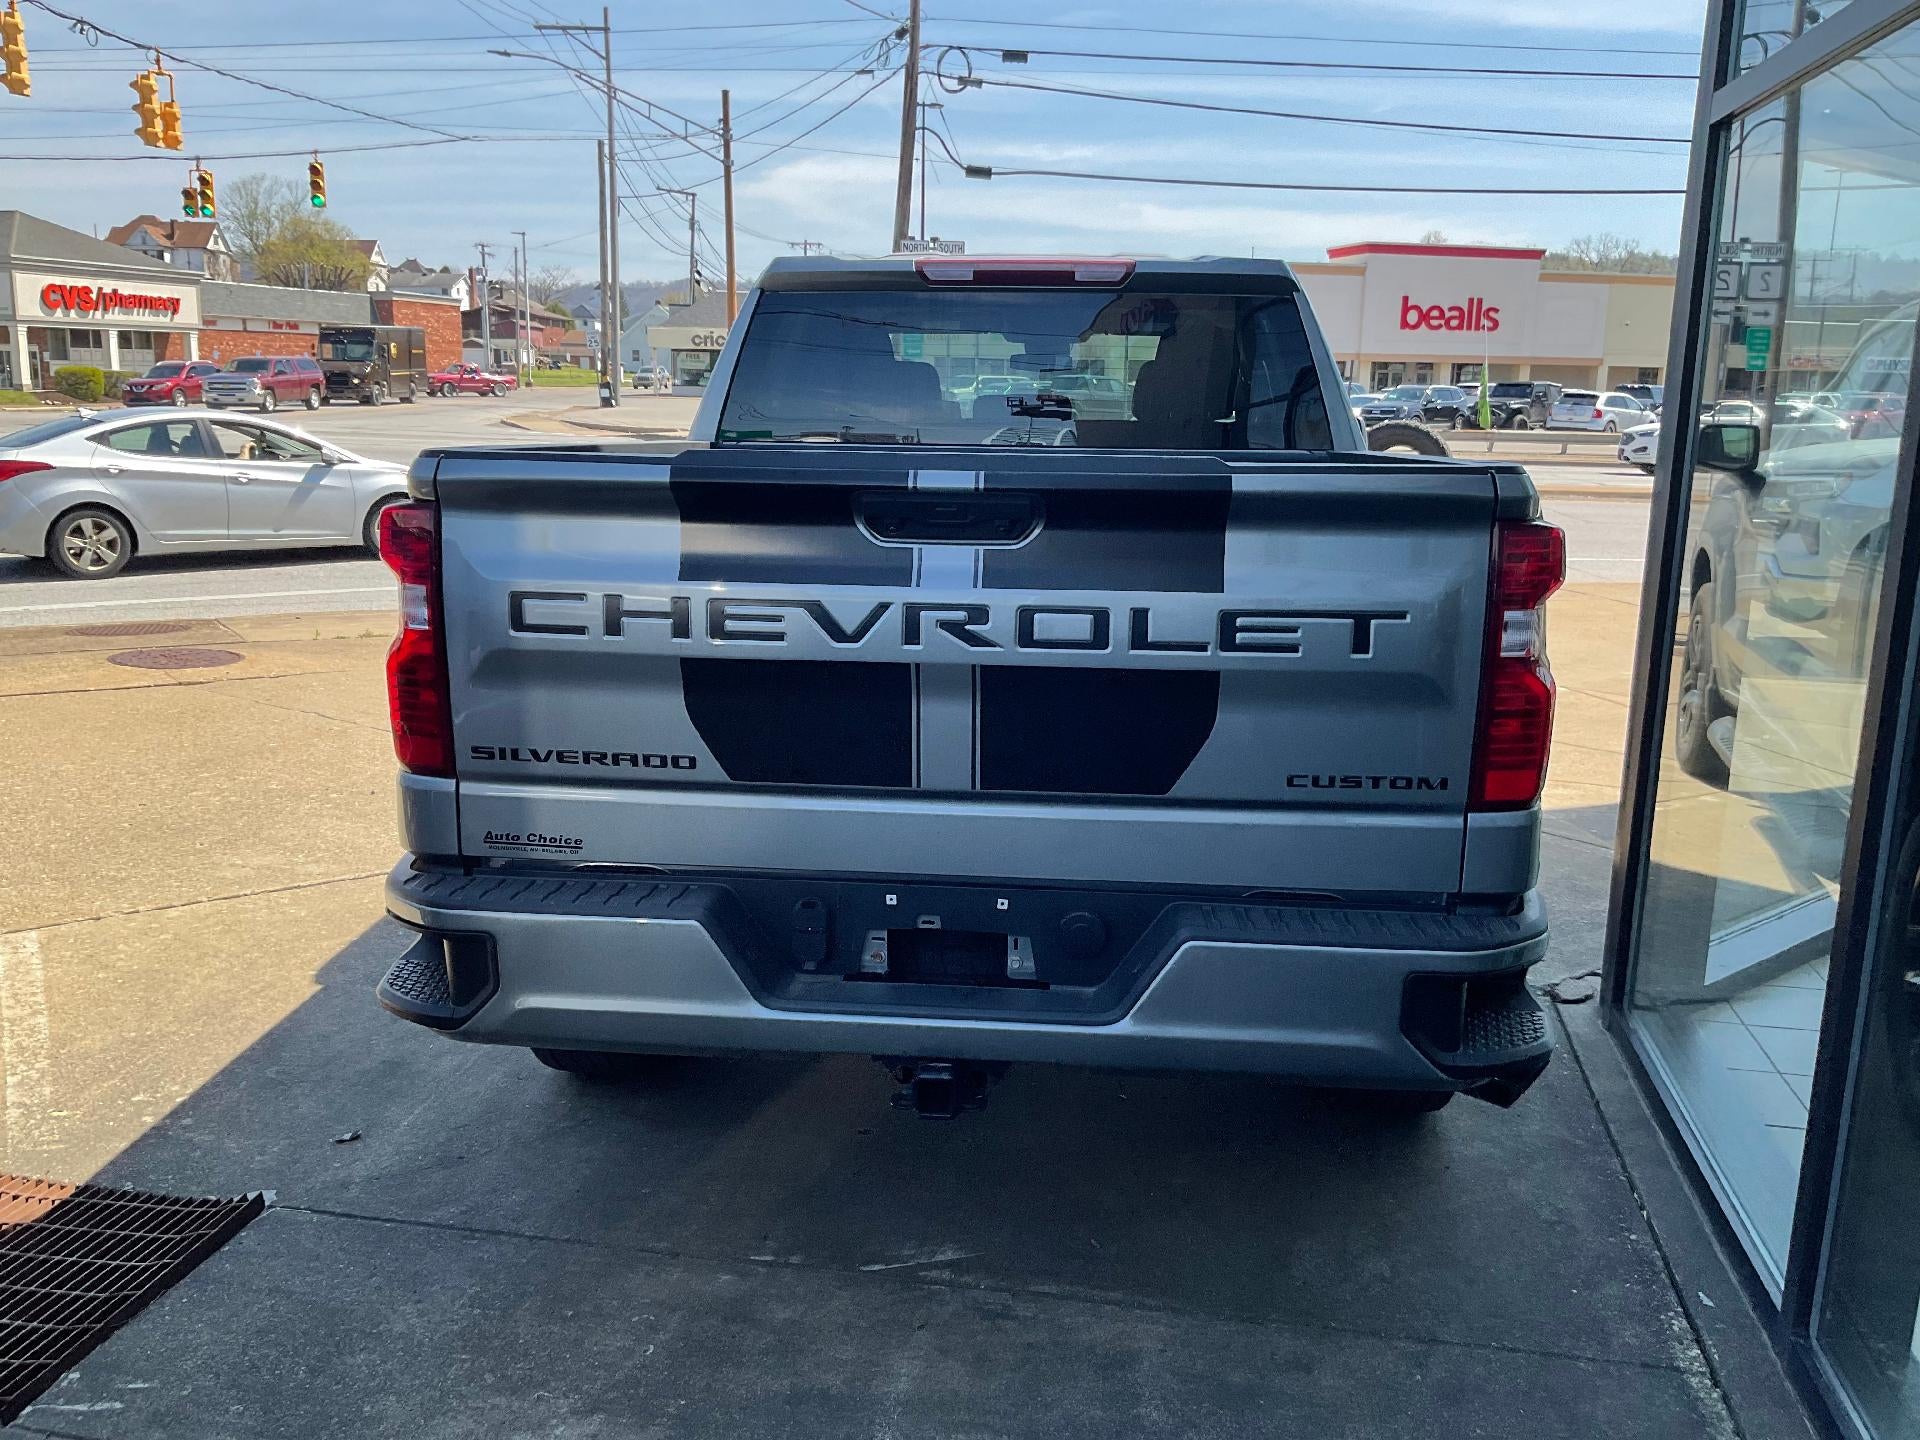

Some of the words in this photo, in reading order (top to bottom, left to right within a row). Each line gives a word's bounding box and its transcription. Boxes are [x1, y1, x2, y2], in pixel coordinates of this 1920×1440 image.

[902, 242, 928, 253] NORTH
[938, 243, 963, 254] SOUTH
[43, 284, 181, 315] CVS/pharmacy
[1400, 295, 1500, 332] bealls
[588, 340, 600, 348] 25
[508, 590, 1411, 660] CHEVROLET
[470, 745, 697, 770] SILVERADO
[1286, 774, 1449, 791] CUSTOM
[483, 830, 520, 842] Auto
[526, 832, 583, 846] Choice
